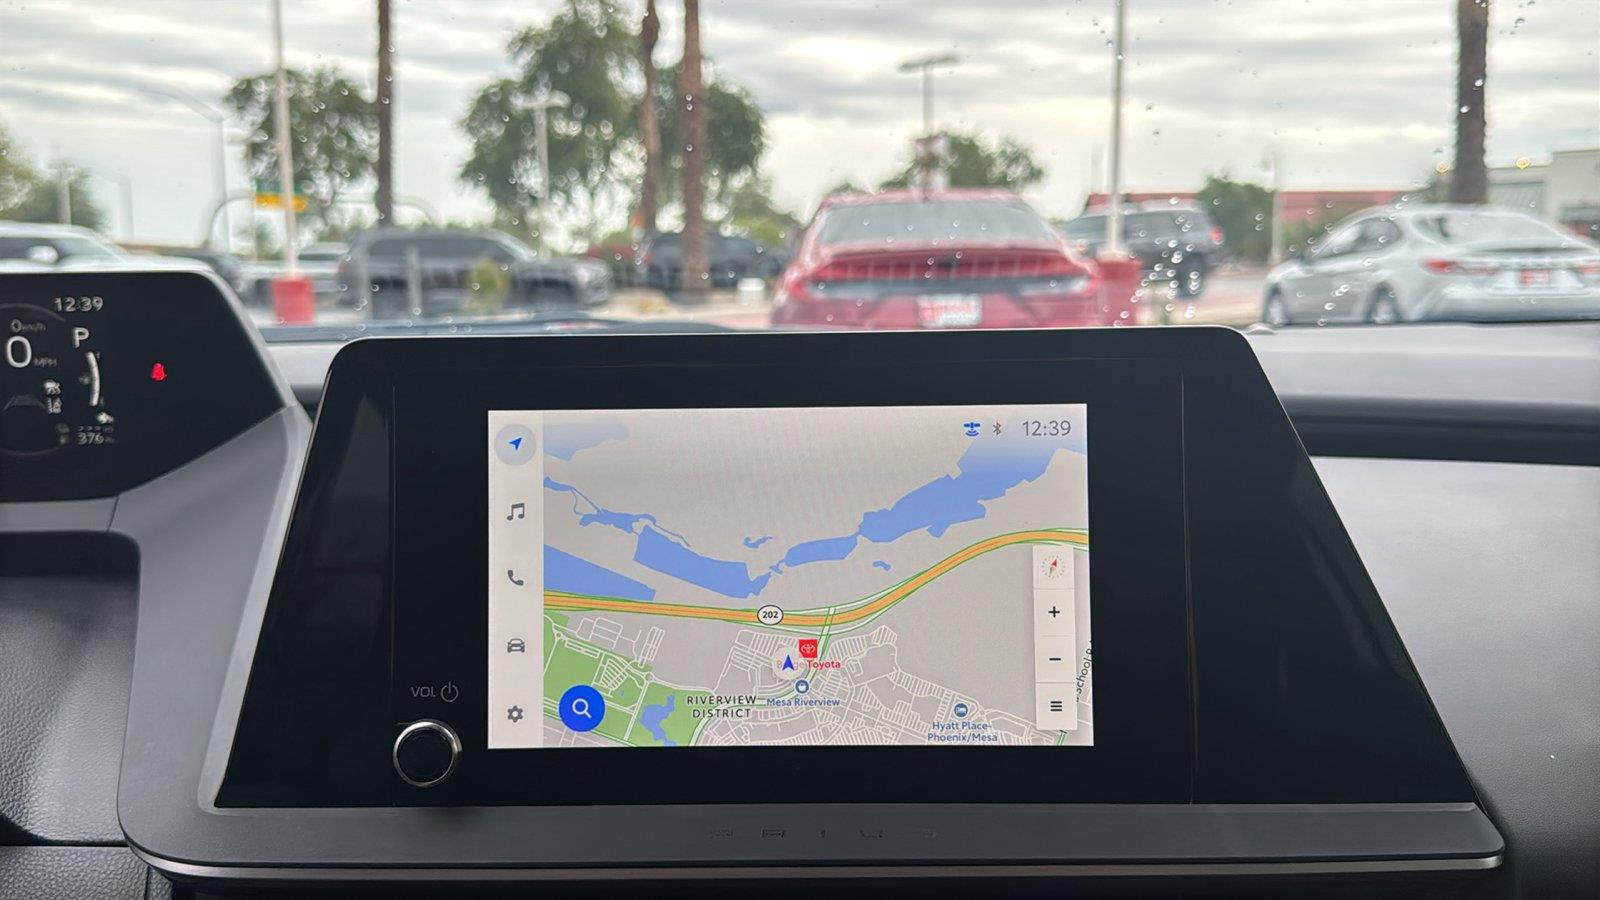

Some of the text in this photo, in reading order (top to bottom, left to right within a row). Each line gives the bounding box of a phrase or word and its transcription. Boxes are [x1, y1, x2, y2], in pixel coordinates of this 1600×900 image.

[54, 296, 104, 312] 12:39
[73, 327, 90, 348] P
[7, 335, 32, 368] 0
[1022, 420, 1072, 437] 12:39
[77, 432, 105, 445] 376
[762, 608, 779, 618] 202
[807, 660, 841, 670] Toyota
[410, 686, 436, 697] VOL
[687, 696, 757, 705] RIVERVIEW
[766, 698, 840, 706] Mesa Riverview
[693, 708, 752, 718] DISTRICT
[932, 721, 992, 732] Hyatt Place-
[927, 732, 998, 743] Phoenix/Mesa
